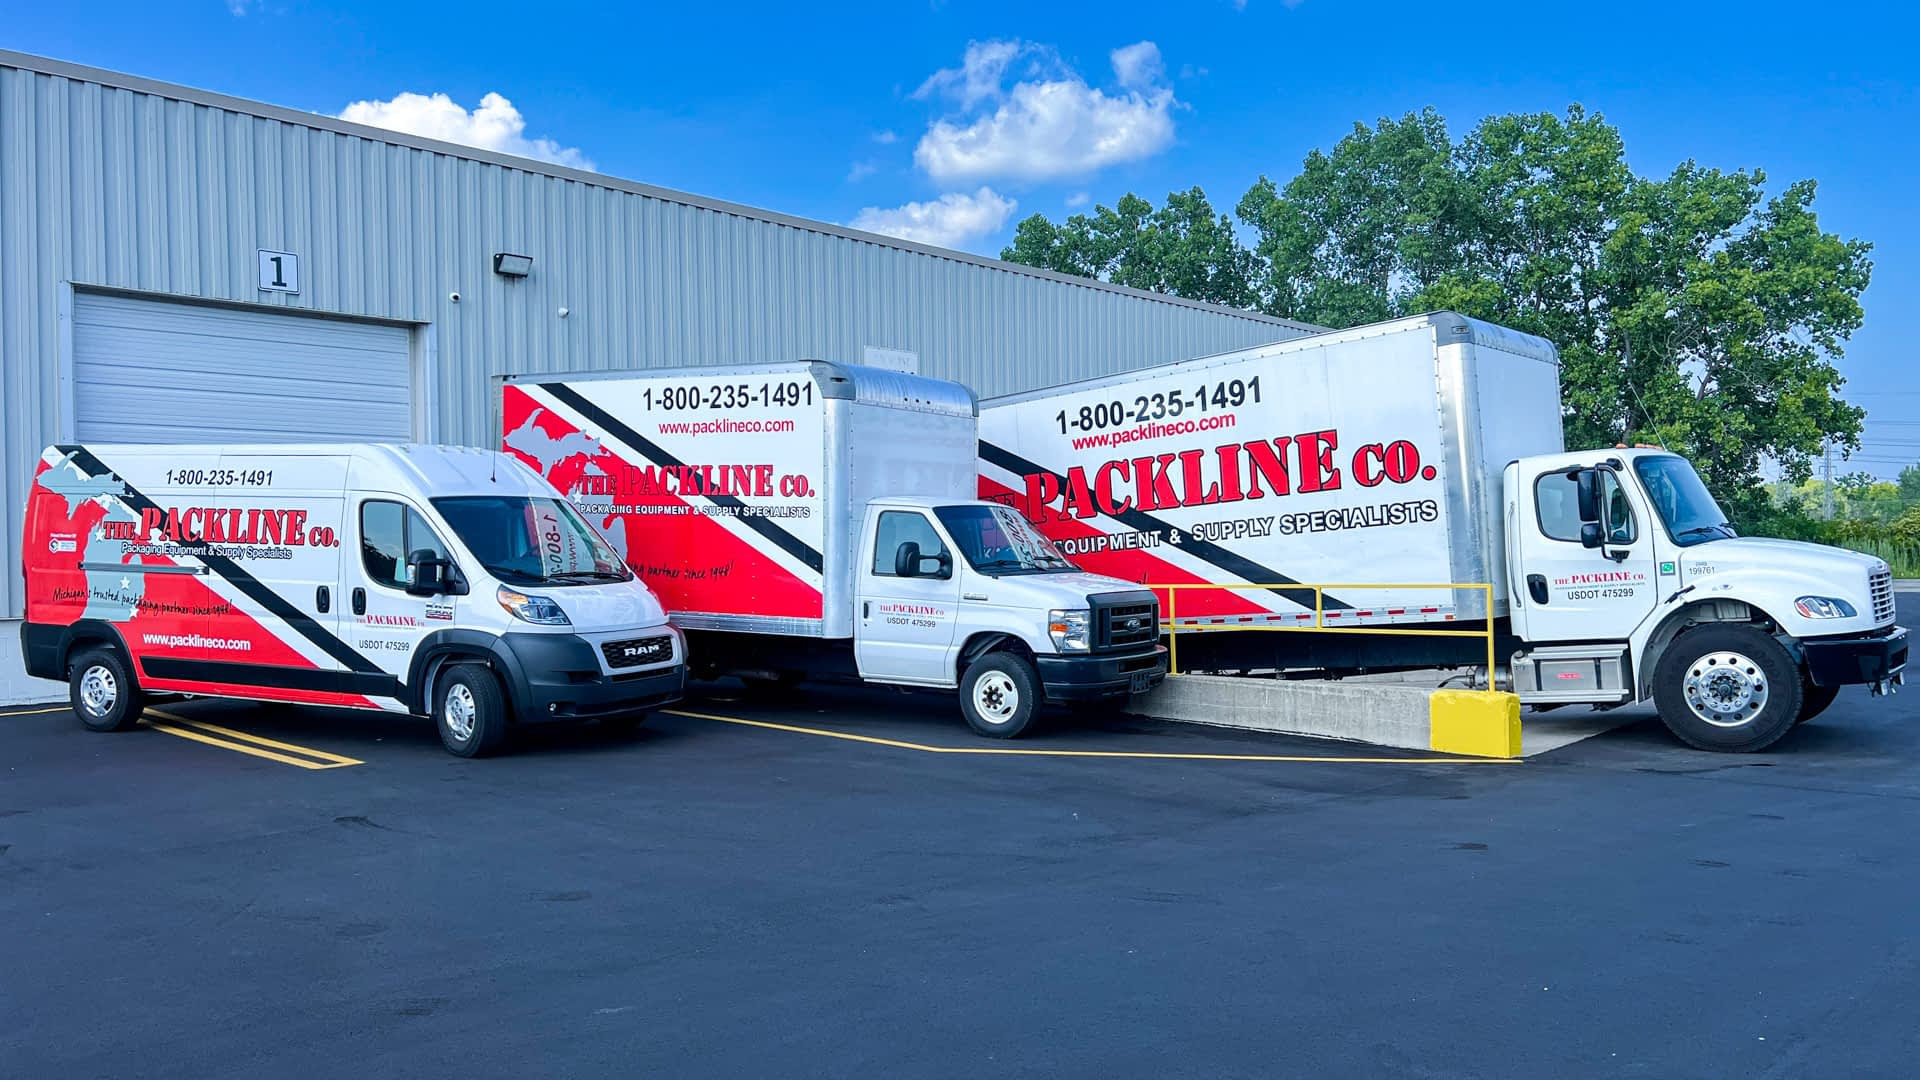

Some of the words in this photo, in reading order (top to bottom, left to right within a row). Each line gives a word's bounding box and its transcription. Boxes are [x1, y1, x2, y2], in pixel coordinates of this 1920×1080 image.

[270, 256, 287, 287] 1
[643, 381, 812, 411] 1-800-235-1491
[1055, 375, 1262, 435] 1-800-235-1491
[658, 419, 795, 437] www.packlineco.com
[1072, 412, 1236, 451] www.packlineco.com
[166, 469, 273, 486] 1-800-235-1491
[579, 475, 617, 495] THE
[623, 465, 774, 497] PACKLINE
[1023, 428, 1342, 525] PACKLINE
[580, 504, 632, 514] PACKAGING
[635, 504, 690, 515] EQUIPMENT
[692, 505, 700, 516] &
[702, 506, 740, 517] SUPPLY
[743, 506, 811, 518] SPECIALISTS
[103, 521, 137, 539] THE
[140, 507, 307, 546] PACKLINE
[1168, 528, 1184, 545] &
[1192, 517, 1274, 543] SUPPLY
[1279, 500, 1438, 535] SPECIALISTS
[121, 542, 162, 556] Packaging
[163, 543, 206, 557] Equipment
[207, 546, 214, 556] &
[215, 545, 246, 560] Supply
[246, 546, 292, 559] Specialists
[1571, 571, 1631, 584] PACKLINE
[94, 586, 120, 602] trusted
[1567, 590, 1600, 600] USDOT
[1602, 588, 1634, 598] 475299
[893, 603, 936, 615] PACKLINE
[367, 614, 417, 627] PACKLINE
[886, 617, 910, 625] USDOT
[911, 619, 936, 627] 475299
[143, 633, 250, 651] www.packlineco.com
[359, 639, 384, 649] USDOT
[385, 641, 410, 651] 475299
[624, 645, 660, 656] RAM
